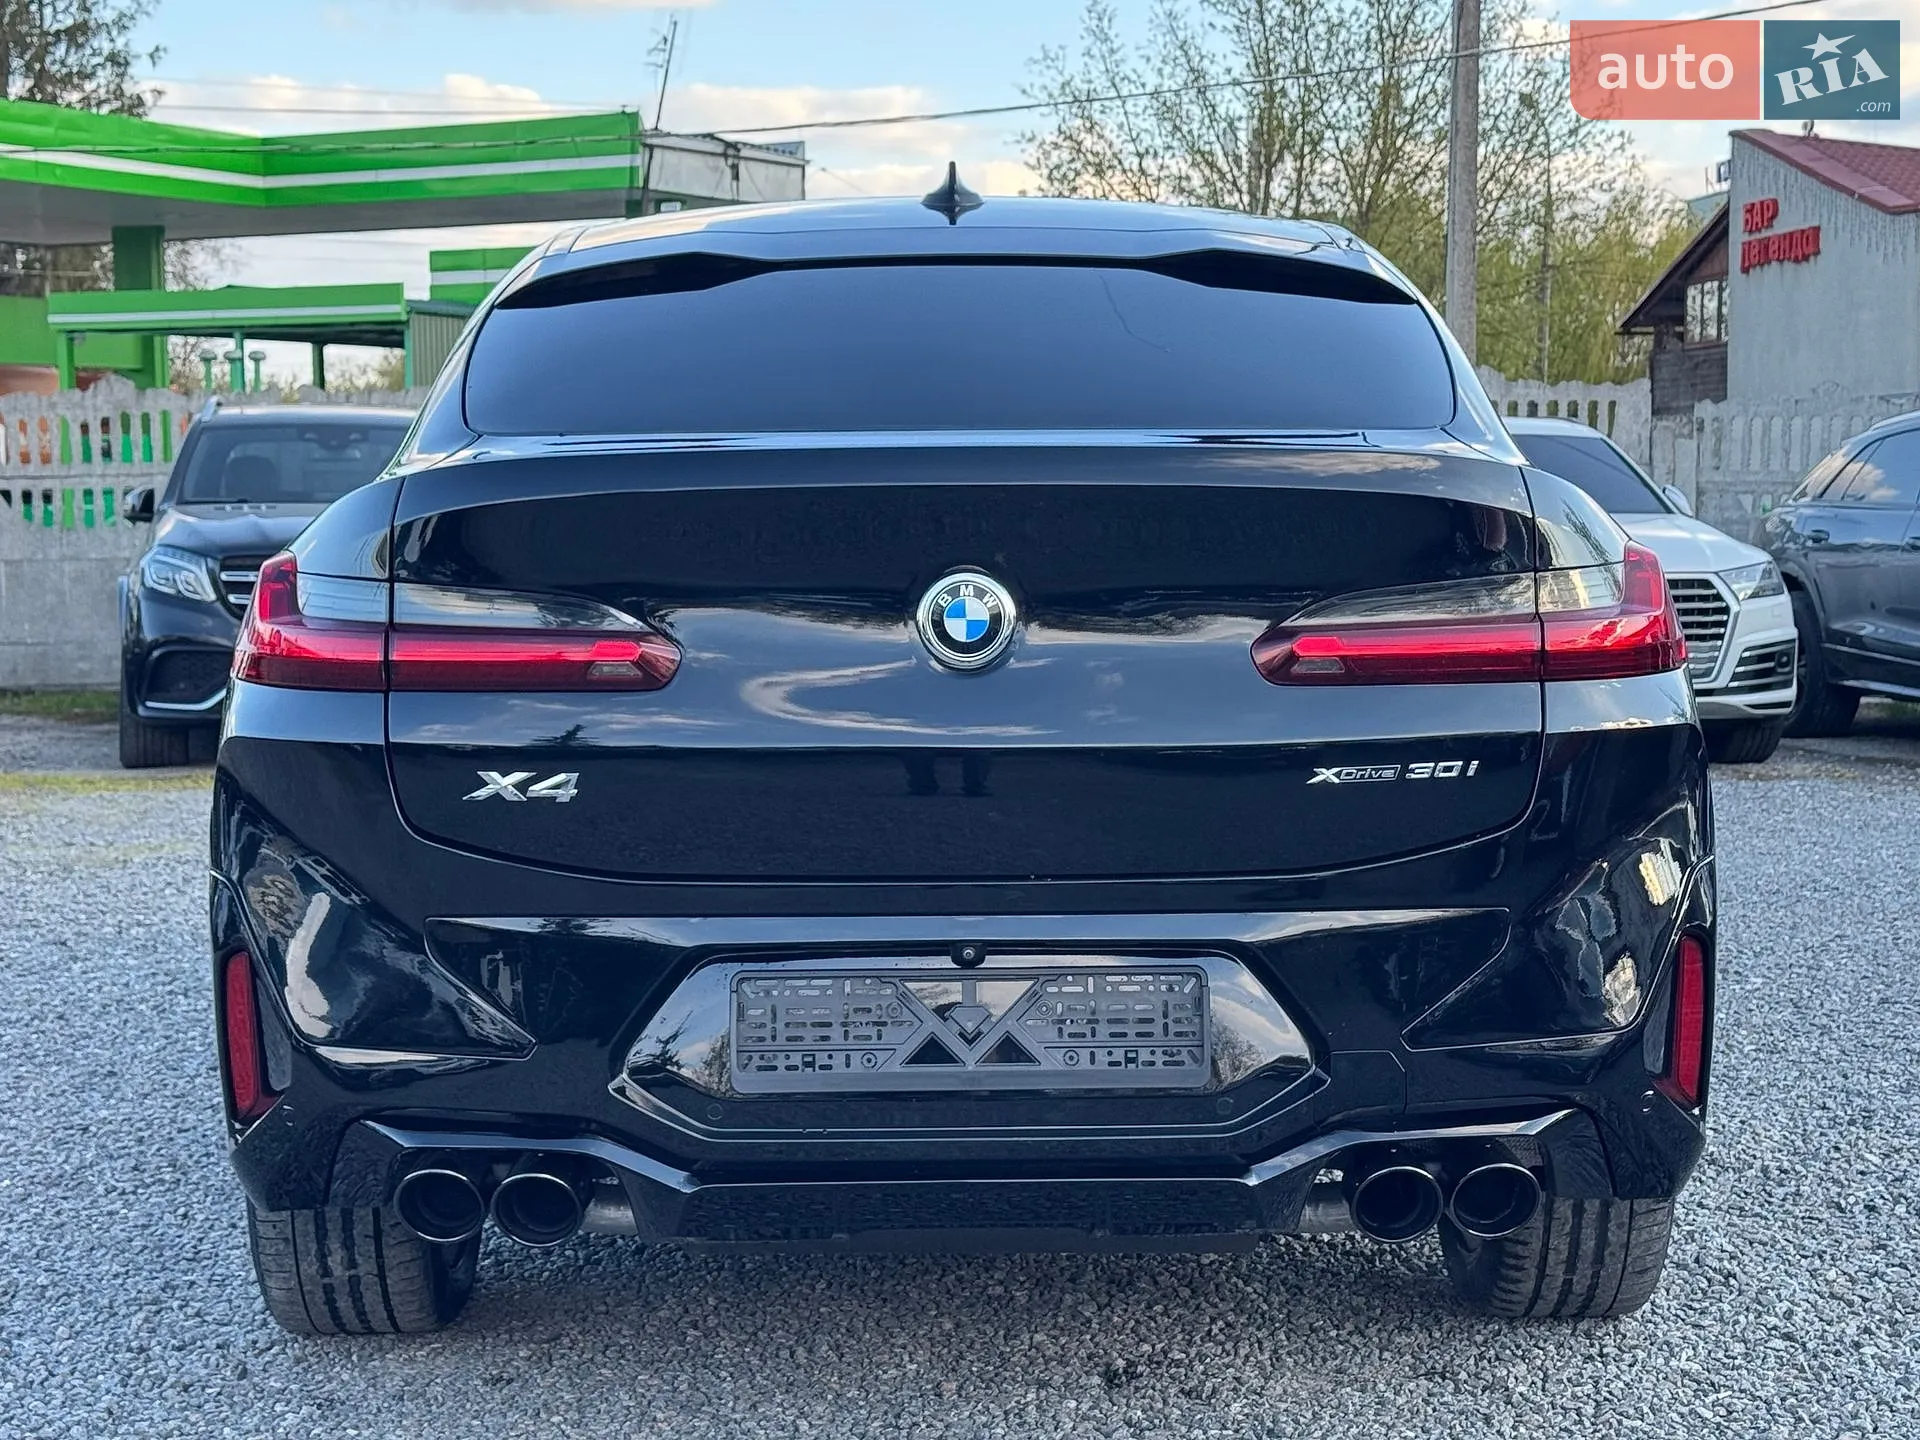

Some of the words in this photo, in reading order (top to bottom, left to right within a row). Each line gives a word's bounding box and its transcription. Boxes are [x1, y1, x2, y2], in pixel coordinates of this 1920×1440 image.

[1743, 198, 1778, 234] БАР
[937, 584, 1000, 608] BMW
[462, 771, 580, 802] X4
